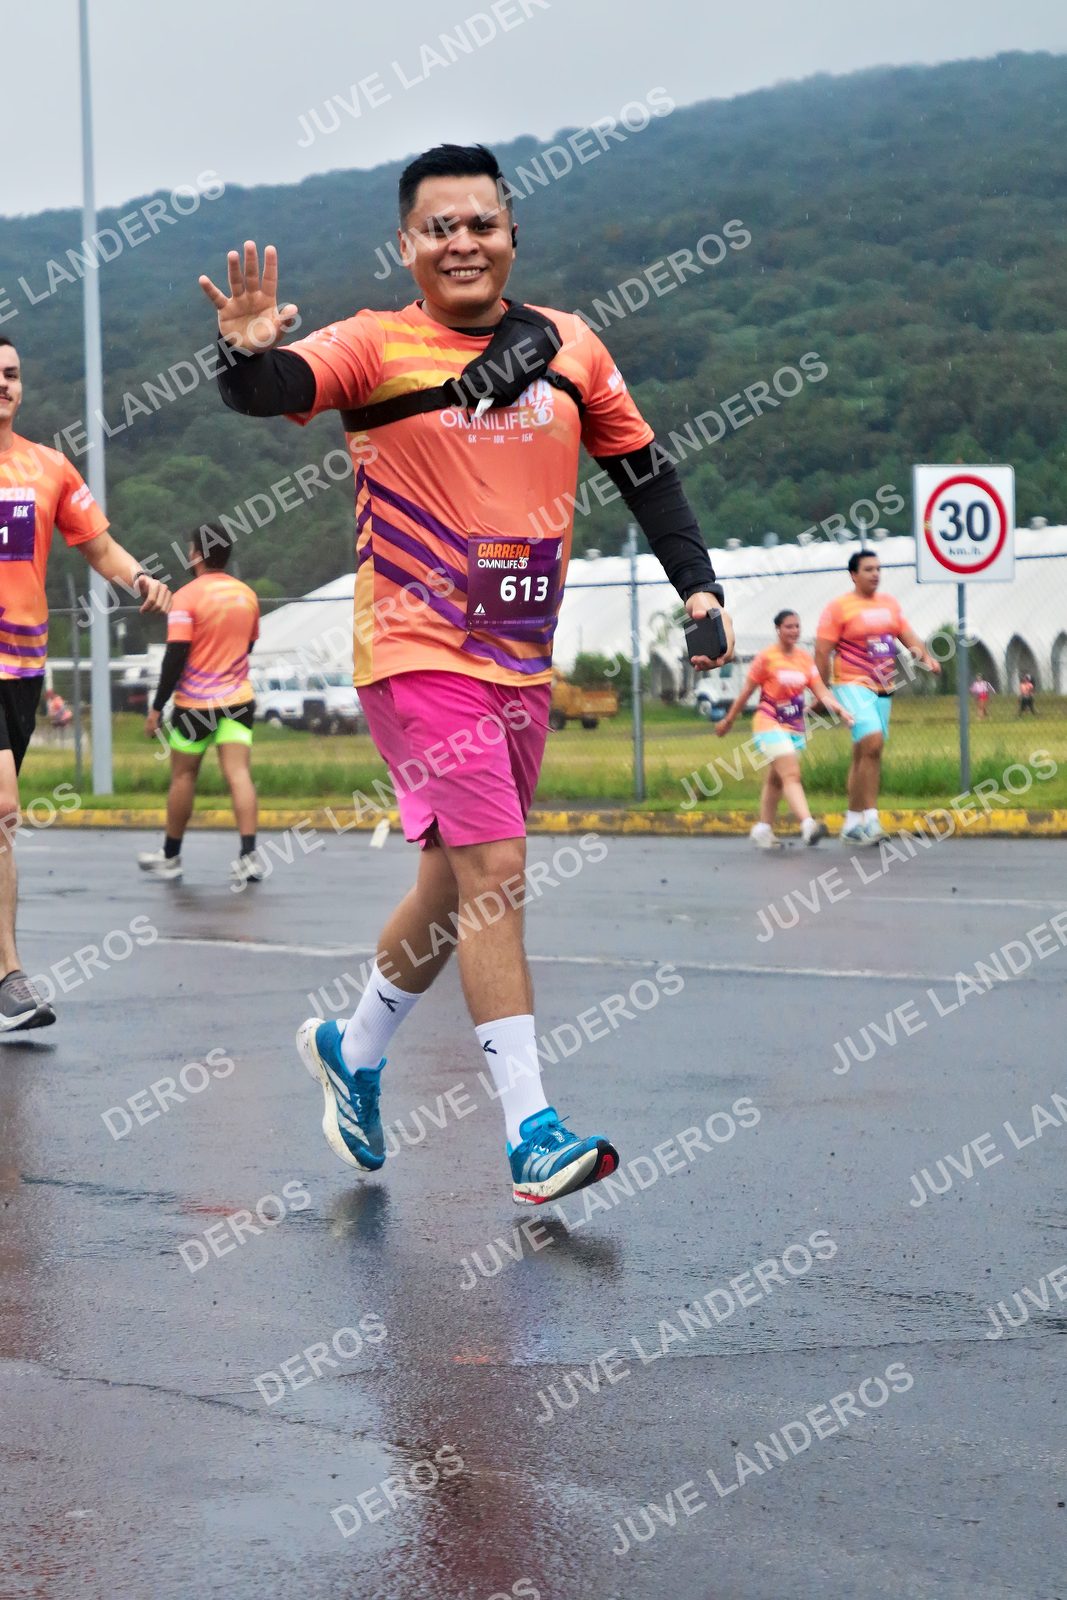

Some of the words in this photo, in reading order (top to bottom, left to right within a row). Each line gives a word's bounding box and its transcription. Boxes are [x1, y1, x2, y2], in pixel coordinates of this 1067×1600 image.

[13, 506, 28, 518] 15K
[938, 500, 991, 542] 30
[478, 543, 531, 559] CARRERA
[500, 576, 549, 602] 613
